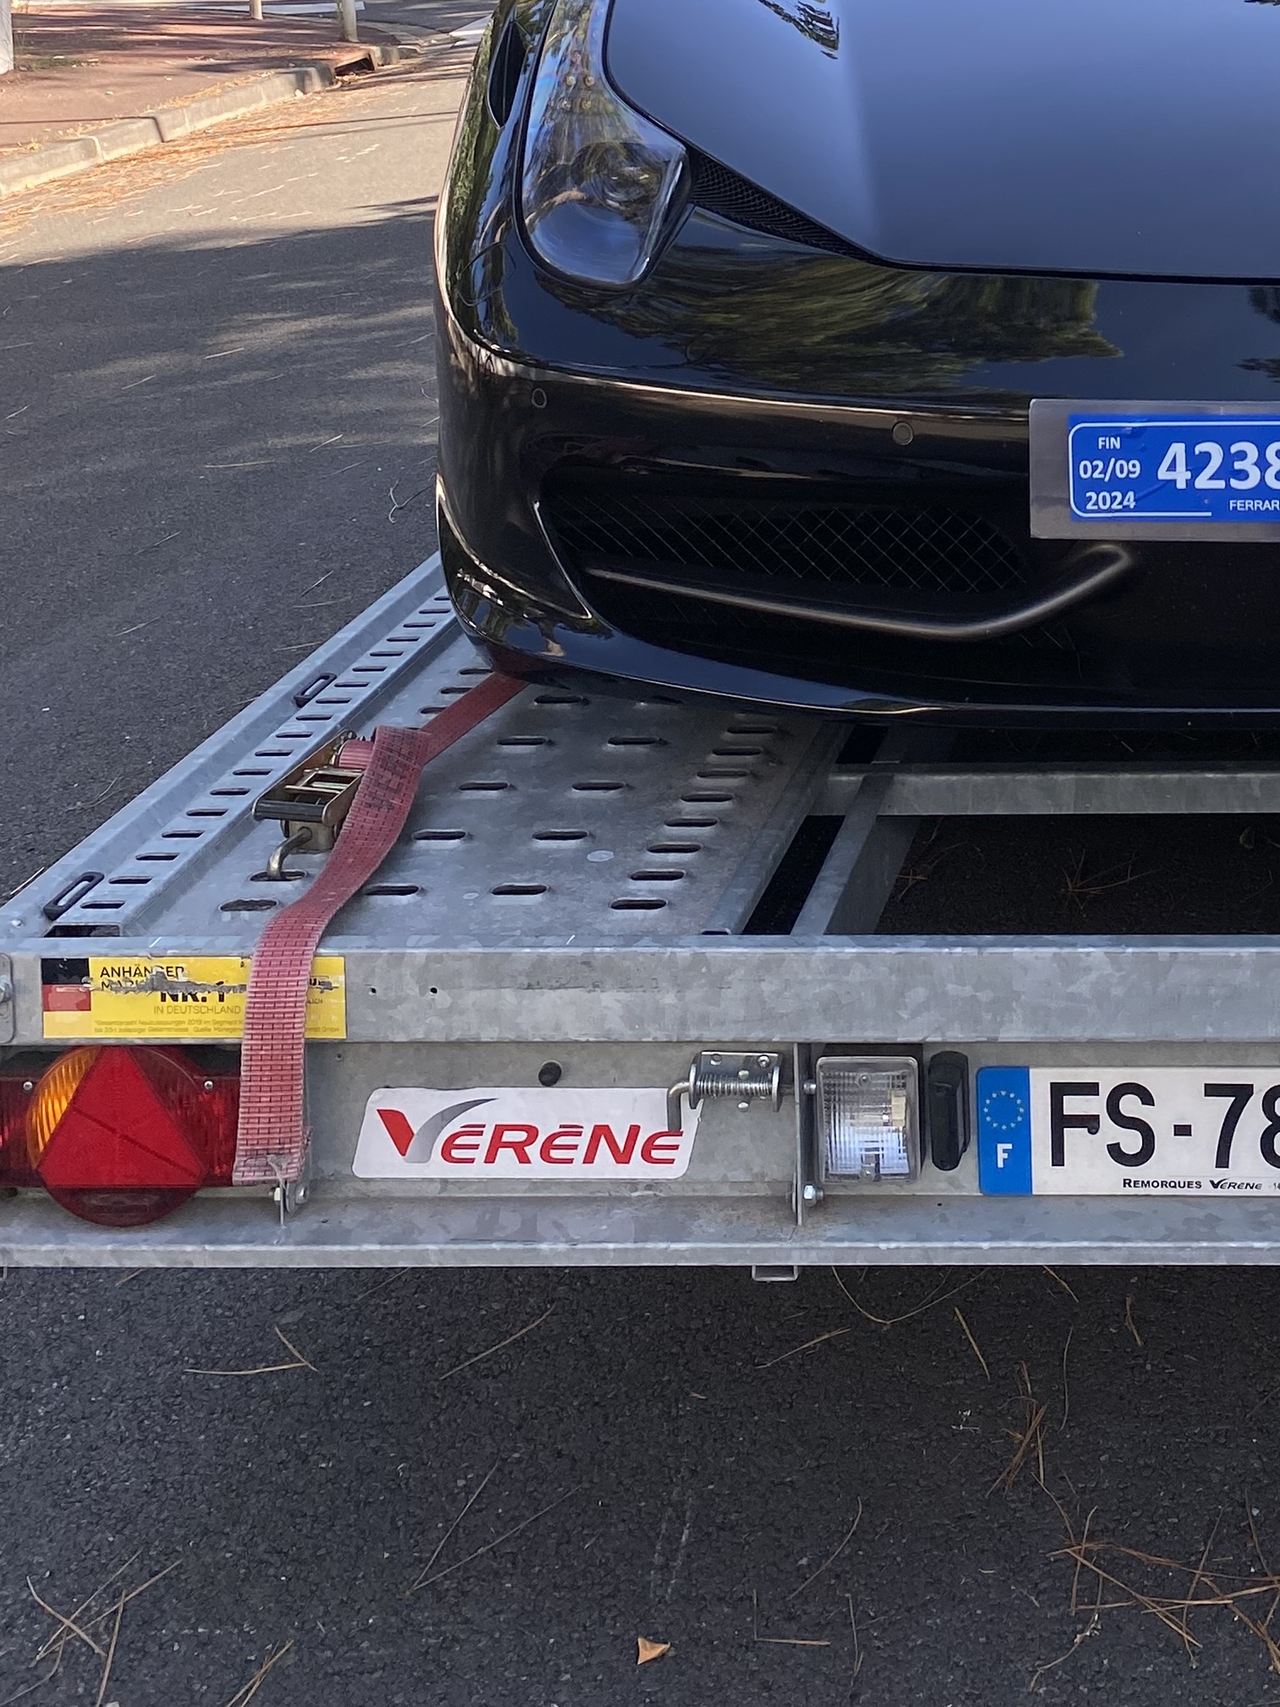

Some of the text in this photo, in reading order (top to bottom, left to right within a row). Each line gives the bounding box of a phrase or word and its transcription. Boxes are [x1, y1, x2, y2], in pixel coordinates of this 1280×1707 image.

[1098, 436, 1121, 449] FIN
[1079, 457, 1141, 482] 02/09
[1085, 491, 1137, 510] 2024
[154, 1005, 242, 1014] IN DEUTSCHLAND
[997, 1143, 1012, 1168] F
[1122, 1178, 1202, 1188] REMORQUES
